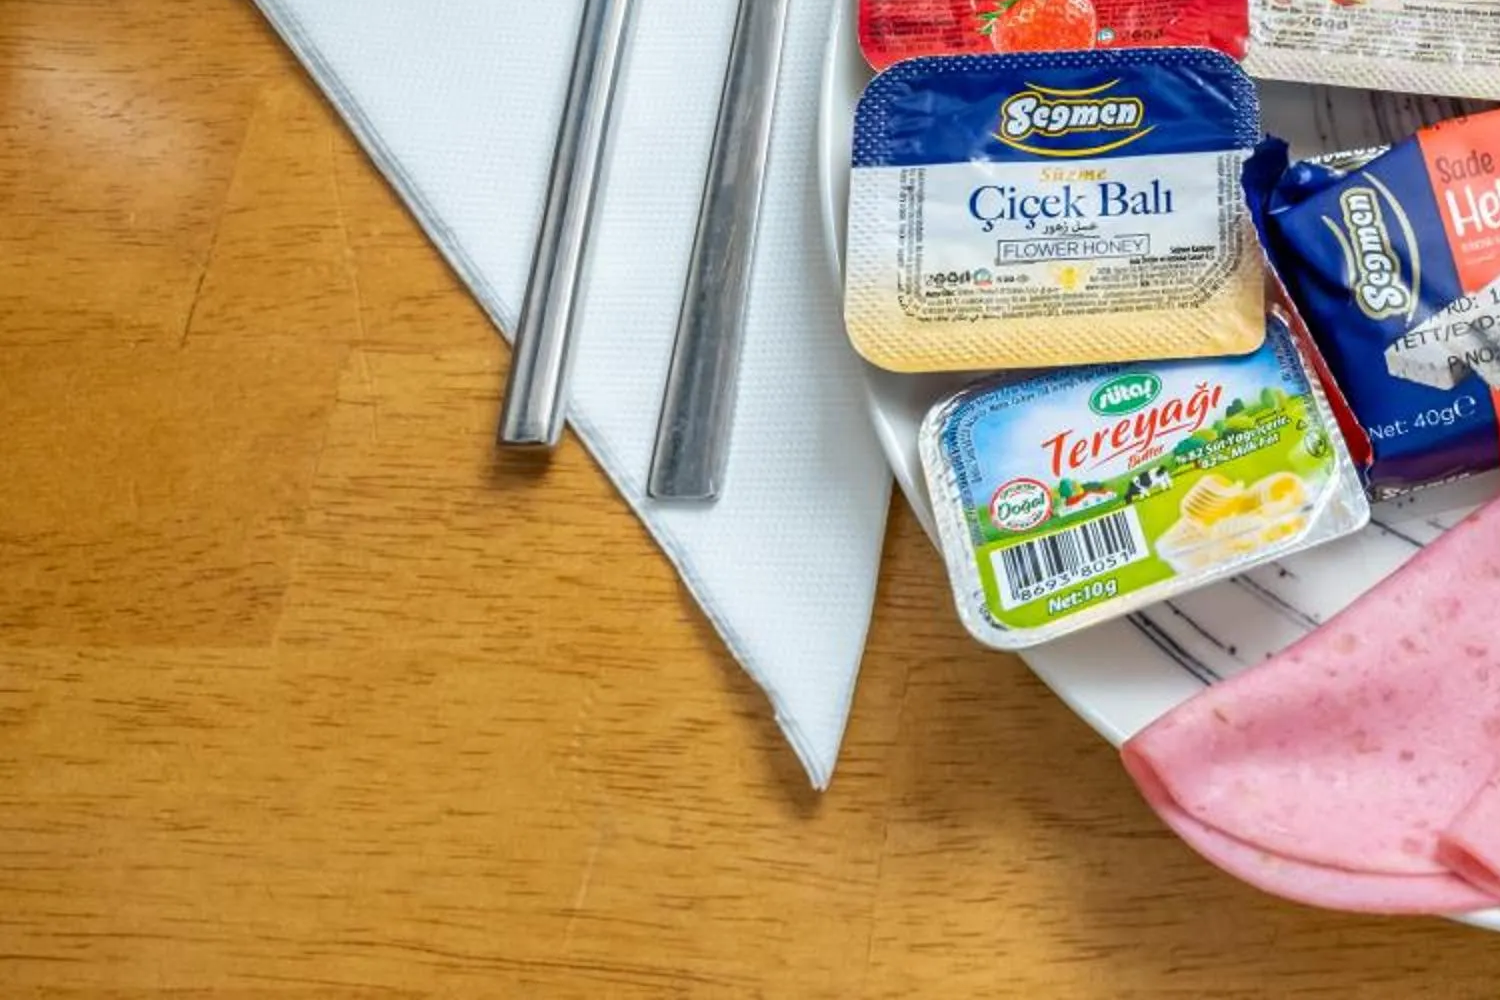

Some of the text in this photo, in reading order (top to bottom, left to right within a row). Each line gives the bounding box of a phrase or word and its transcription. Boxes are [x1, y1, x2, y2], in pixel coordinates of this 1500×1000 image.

[1435, 149, 1495, 184] Sade
[968, 183, 1086, 232] Çiçek
[1097, 178, 1174, 217] Balı
[1002, 238, 1144, 259] FLOWER HONEY
[1042, 381, 1223, 477] Tereyağı
[1368, 419, 1410, 441] Net:
